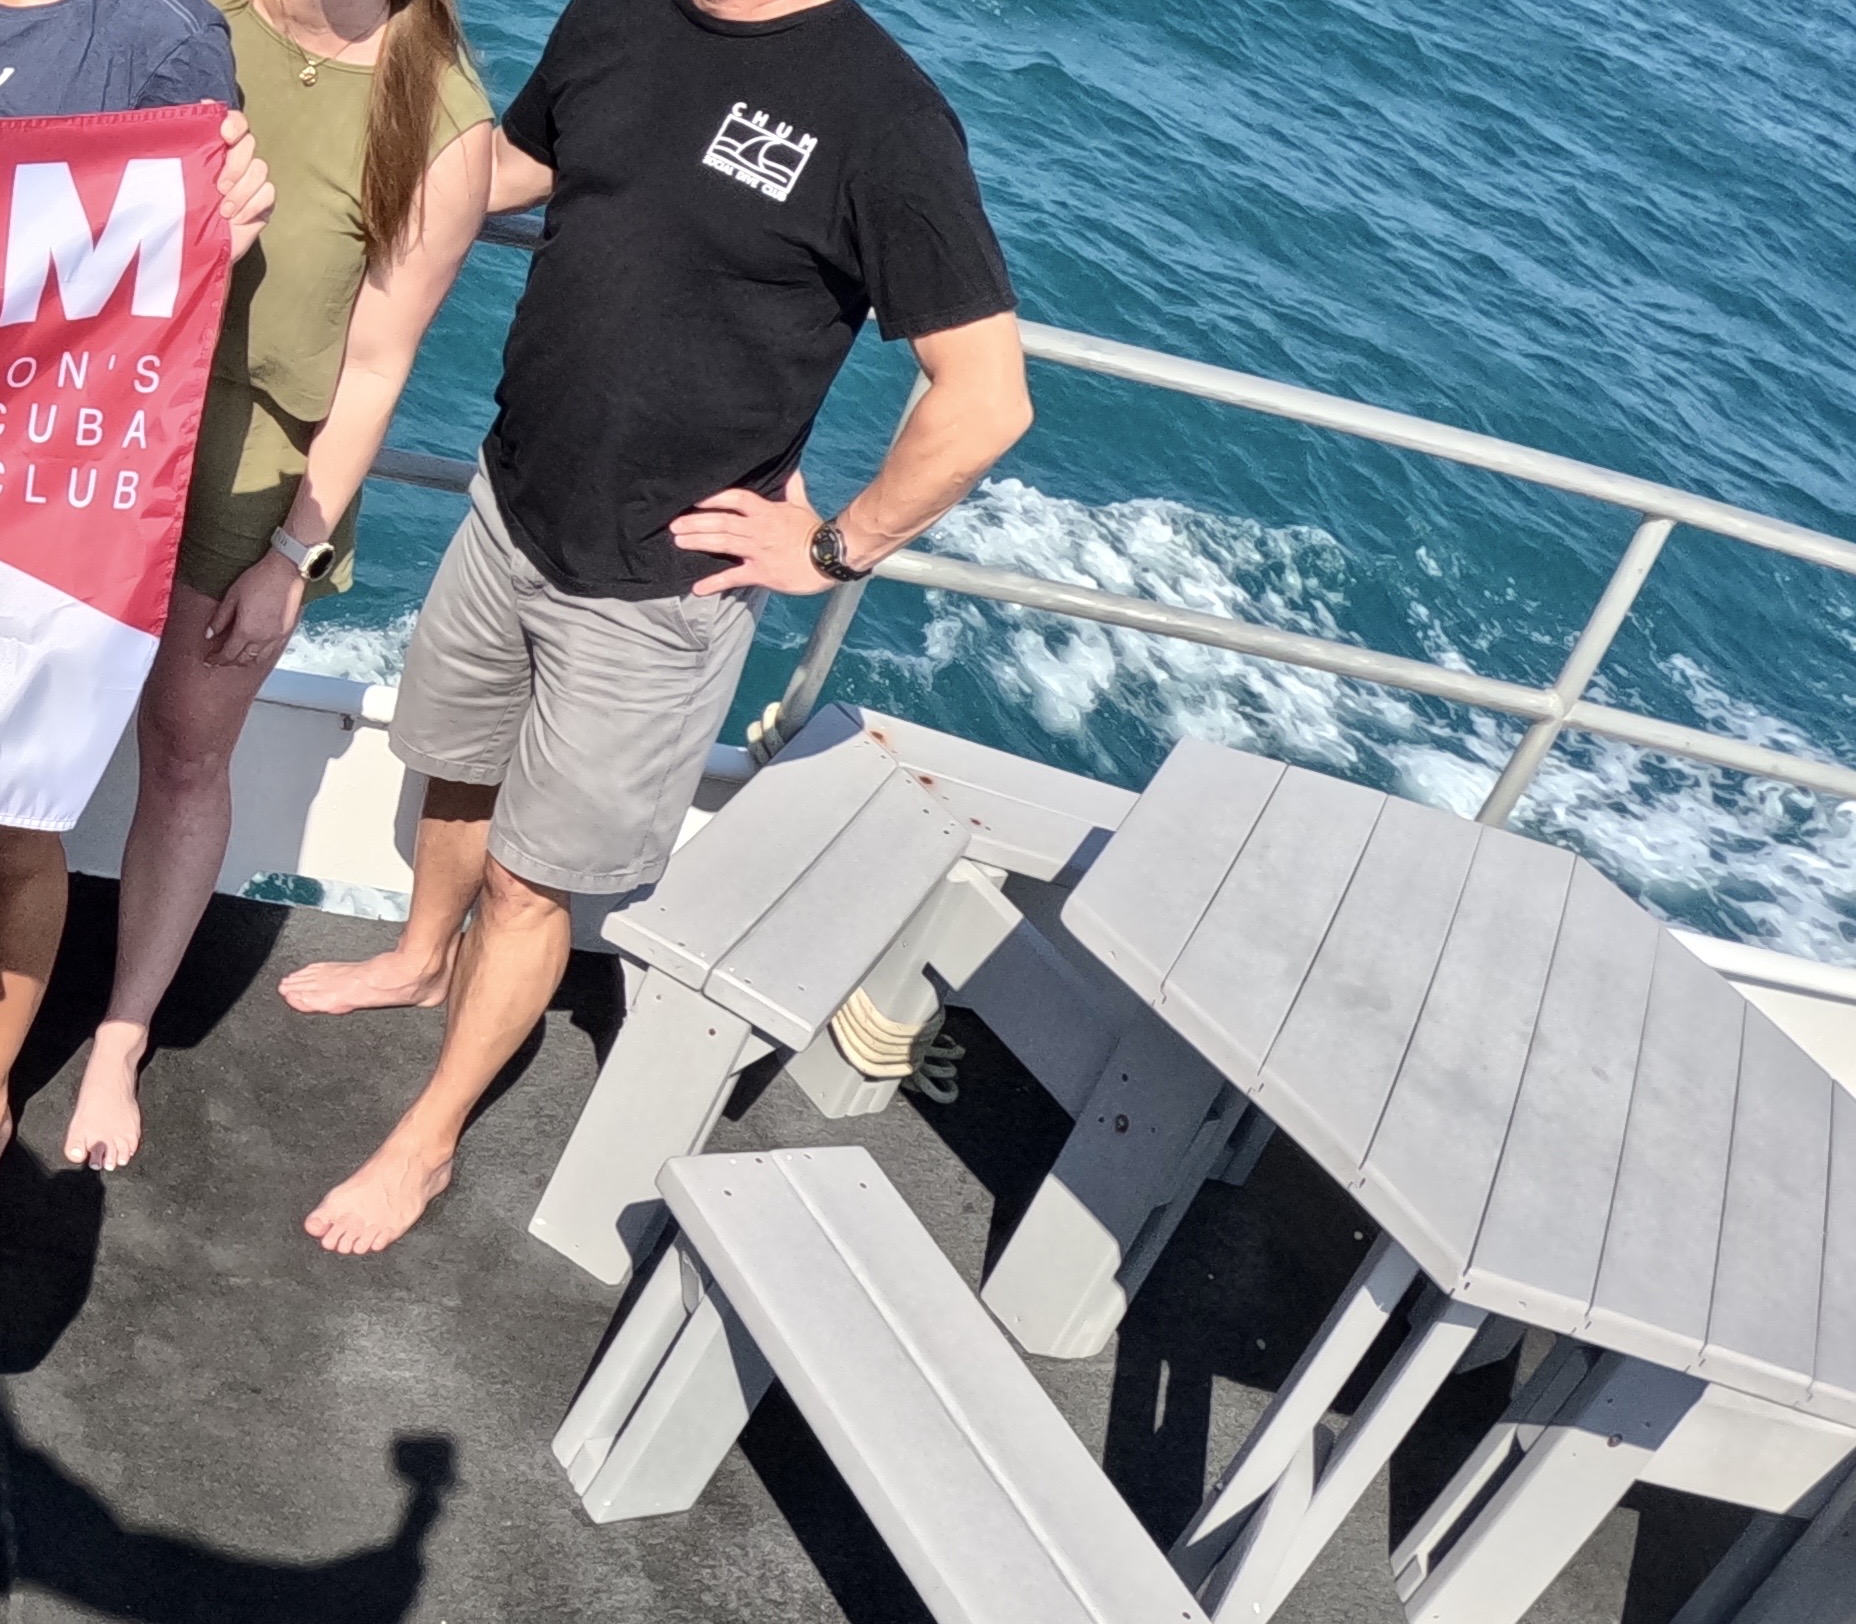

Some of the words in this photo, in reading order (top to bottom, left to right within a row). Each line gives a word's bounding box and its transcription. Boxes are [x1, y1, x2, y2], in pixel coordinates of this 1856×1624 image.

[732, 101, 818, 153] CHUM
[702, 154, 734, 176] SOCIAL
[735, 169, 761, 188] DIVE
[761, 182, 788, 202] CLUB
